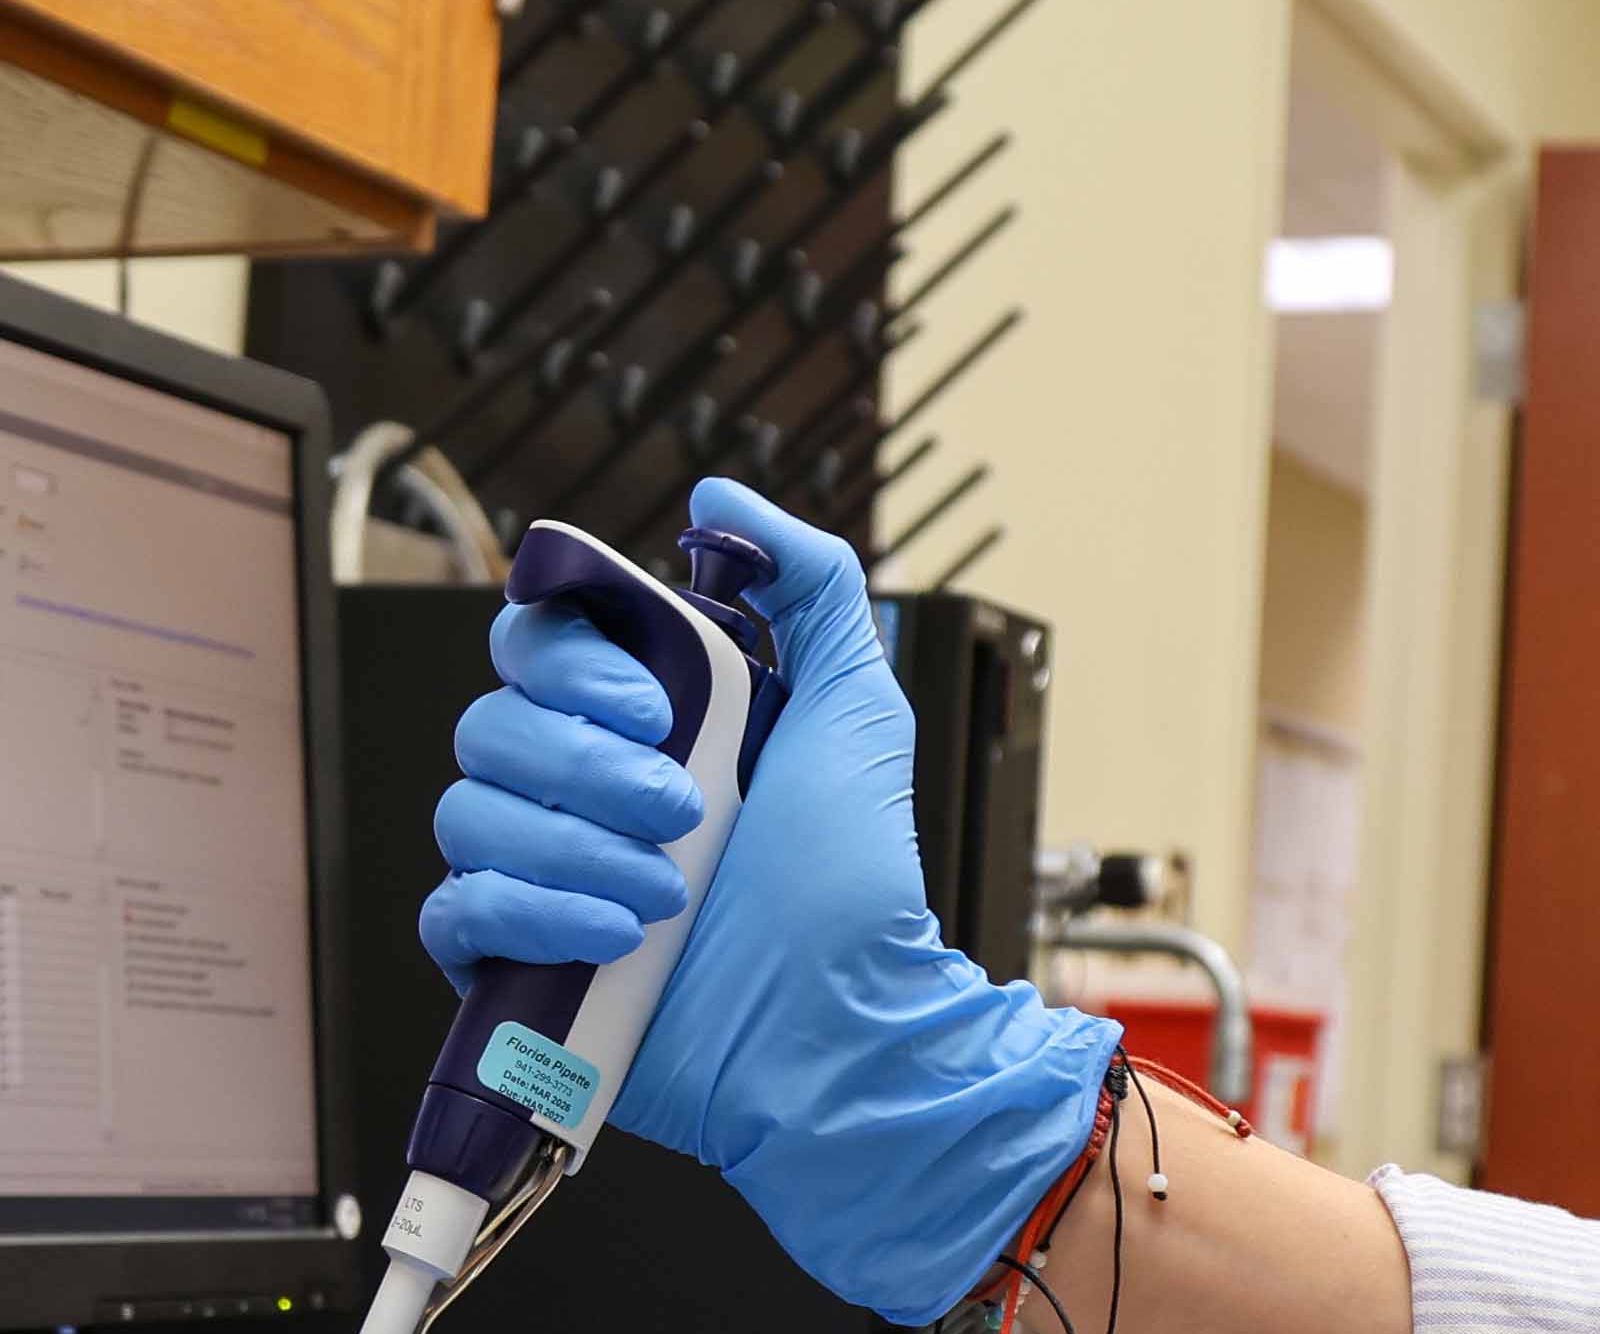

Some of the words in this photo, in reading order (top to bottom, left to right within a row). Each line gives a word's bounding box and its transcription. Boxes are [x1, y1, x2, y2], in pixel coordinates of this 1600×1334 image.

[506, 1036, 551, 1066] Florida
[552, 1060, 592, 1090] Pipette
[514, 1060, 574, 1097] 941-299-3773
[498, 1083, 522, 1101] Due:
[521, 1096, 544, 1114] MAR
[503, 1069, 529, 1088] Date:
[530, 1083, 552, 1101] MAR
